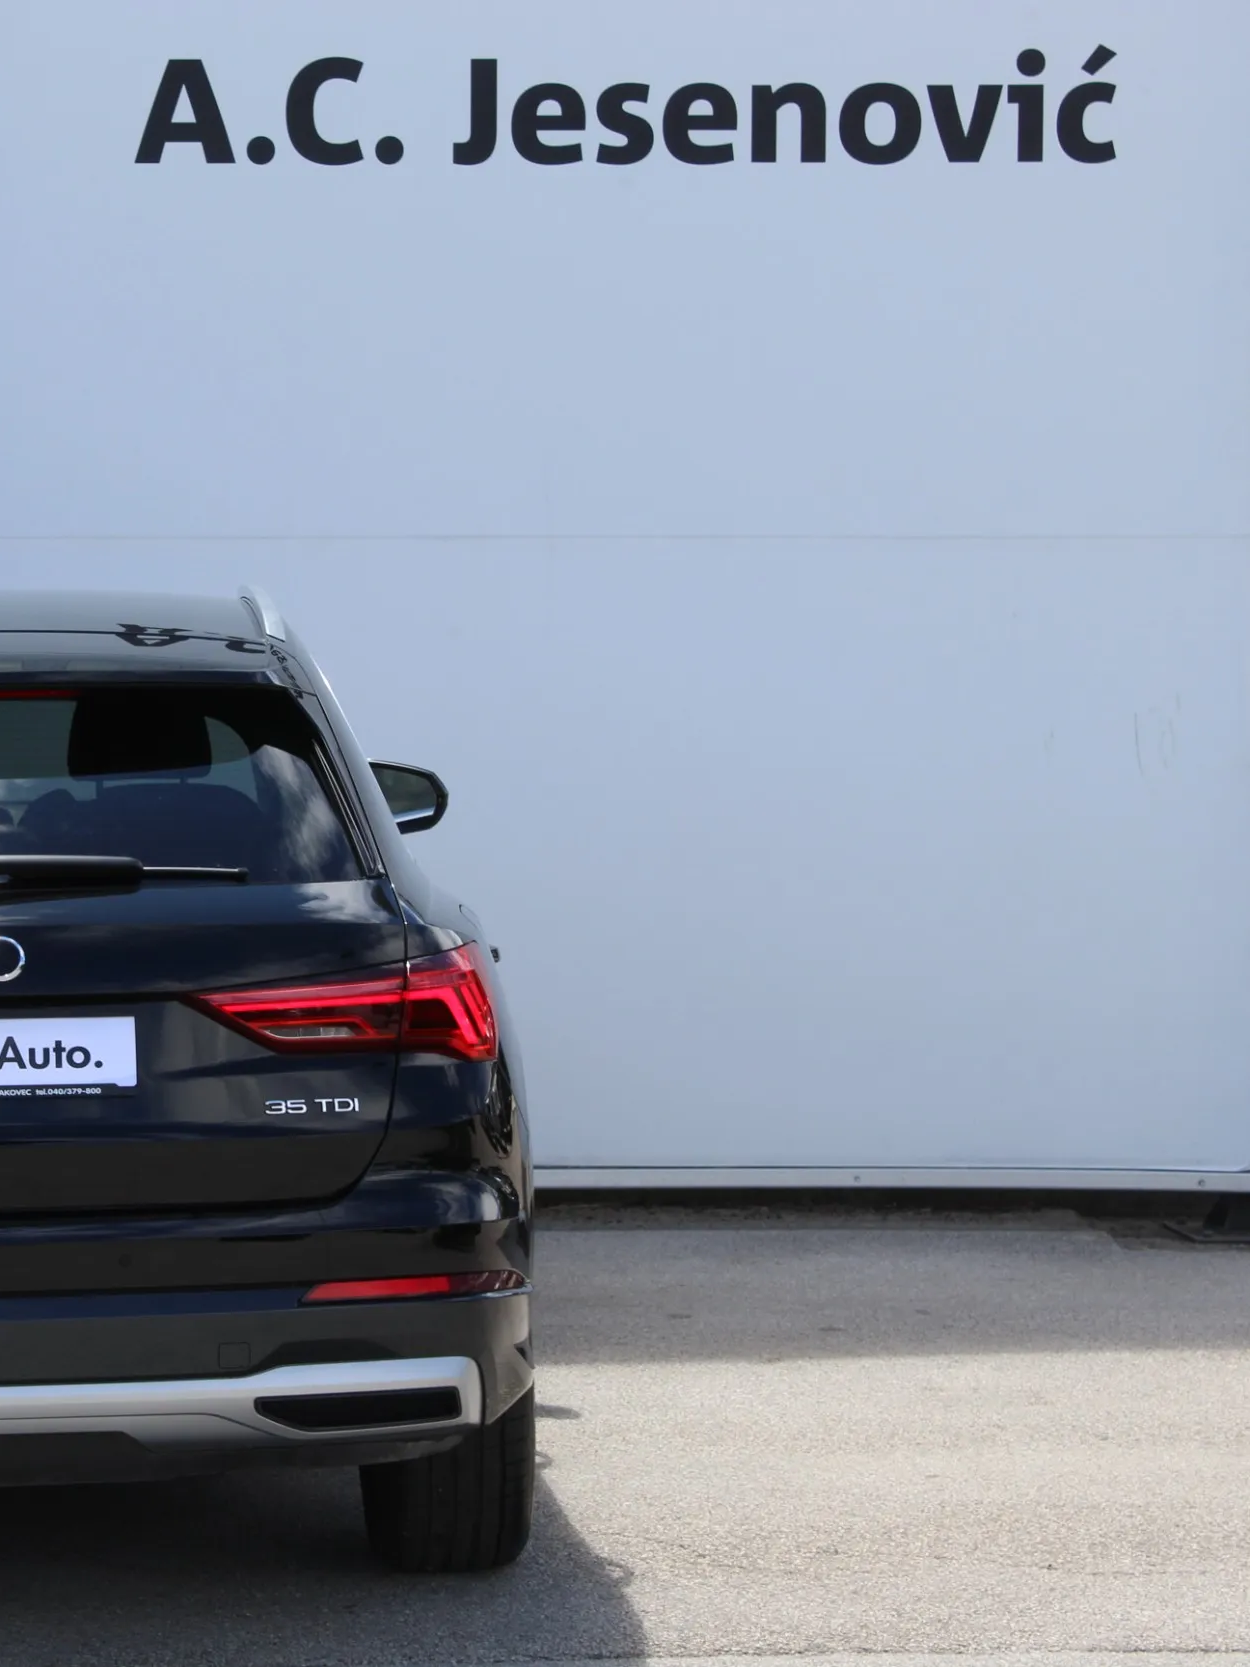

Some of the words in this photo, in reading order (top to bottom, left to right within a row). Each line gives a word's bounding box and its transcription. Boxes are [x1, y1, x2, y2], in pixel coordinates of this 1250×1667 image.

[134, 55, 404, 166] A.C.
[452, 43, 1118, 166] Jesenović
[265, 1099, 307, 1114] 35
[314, 1098, 359, 1113] TDI
